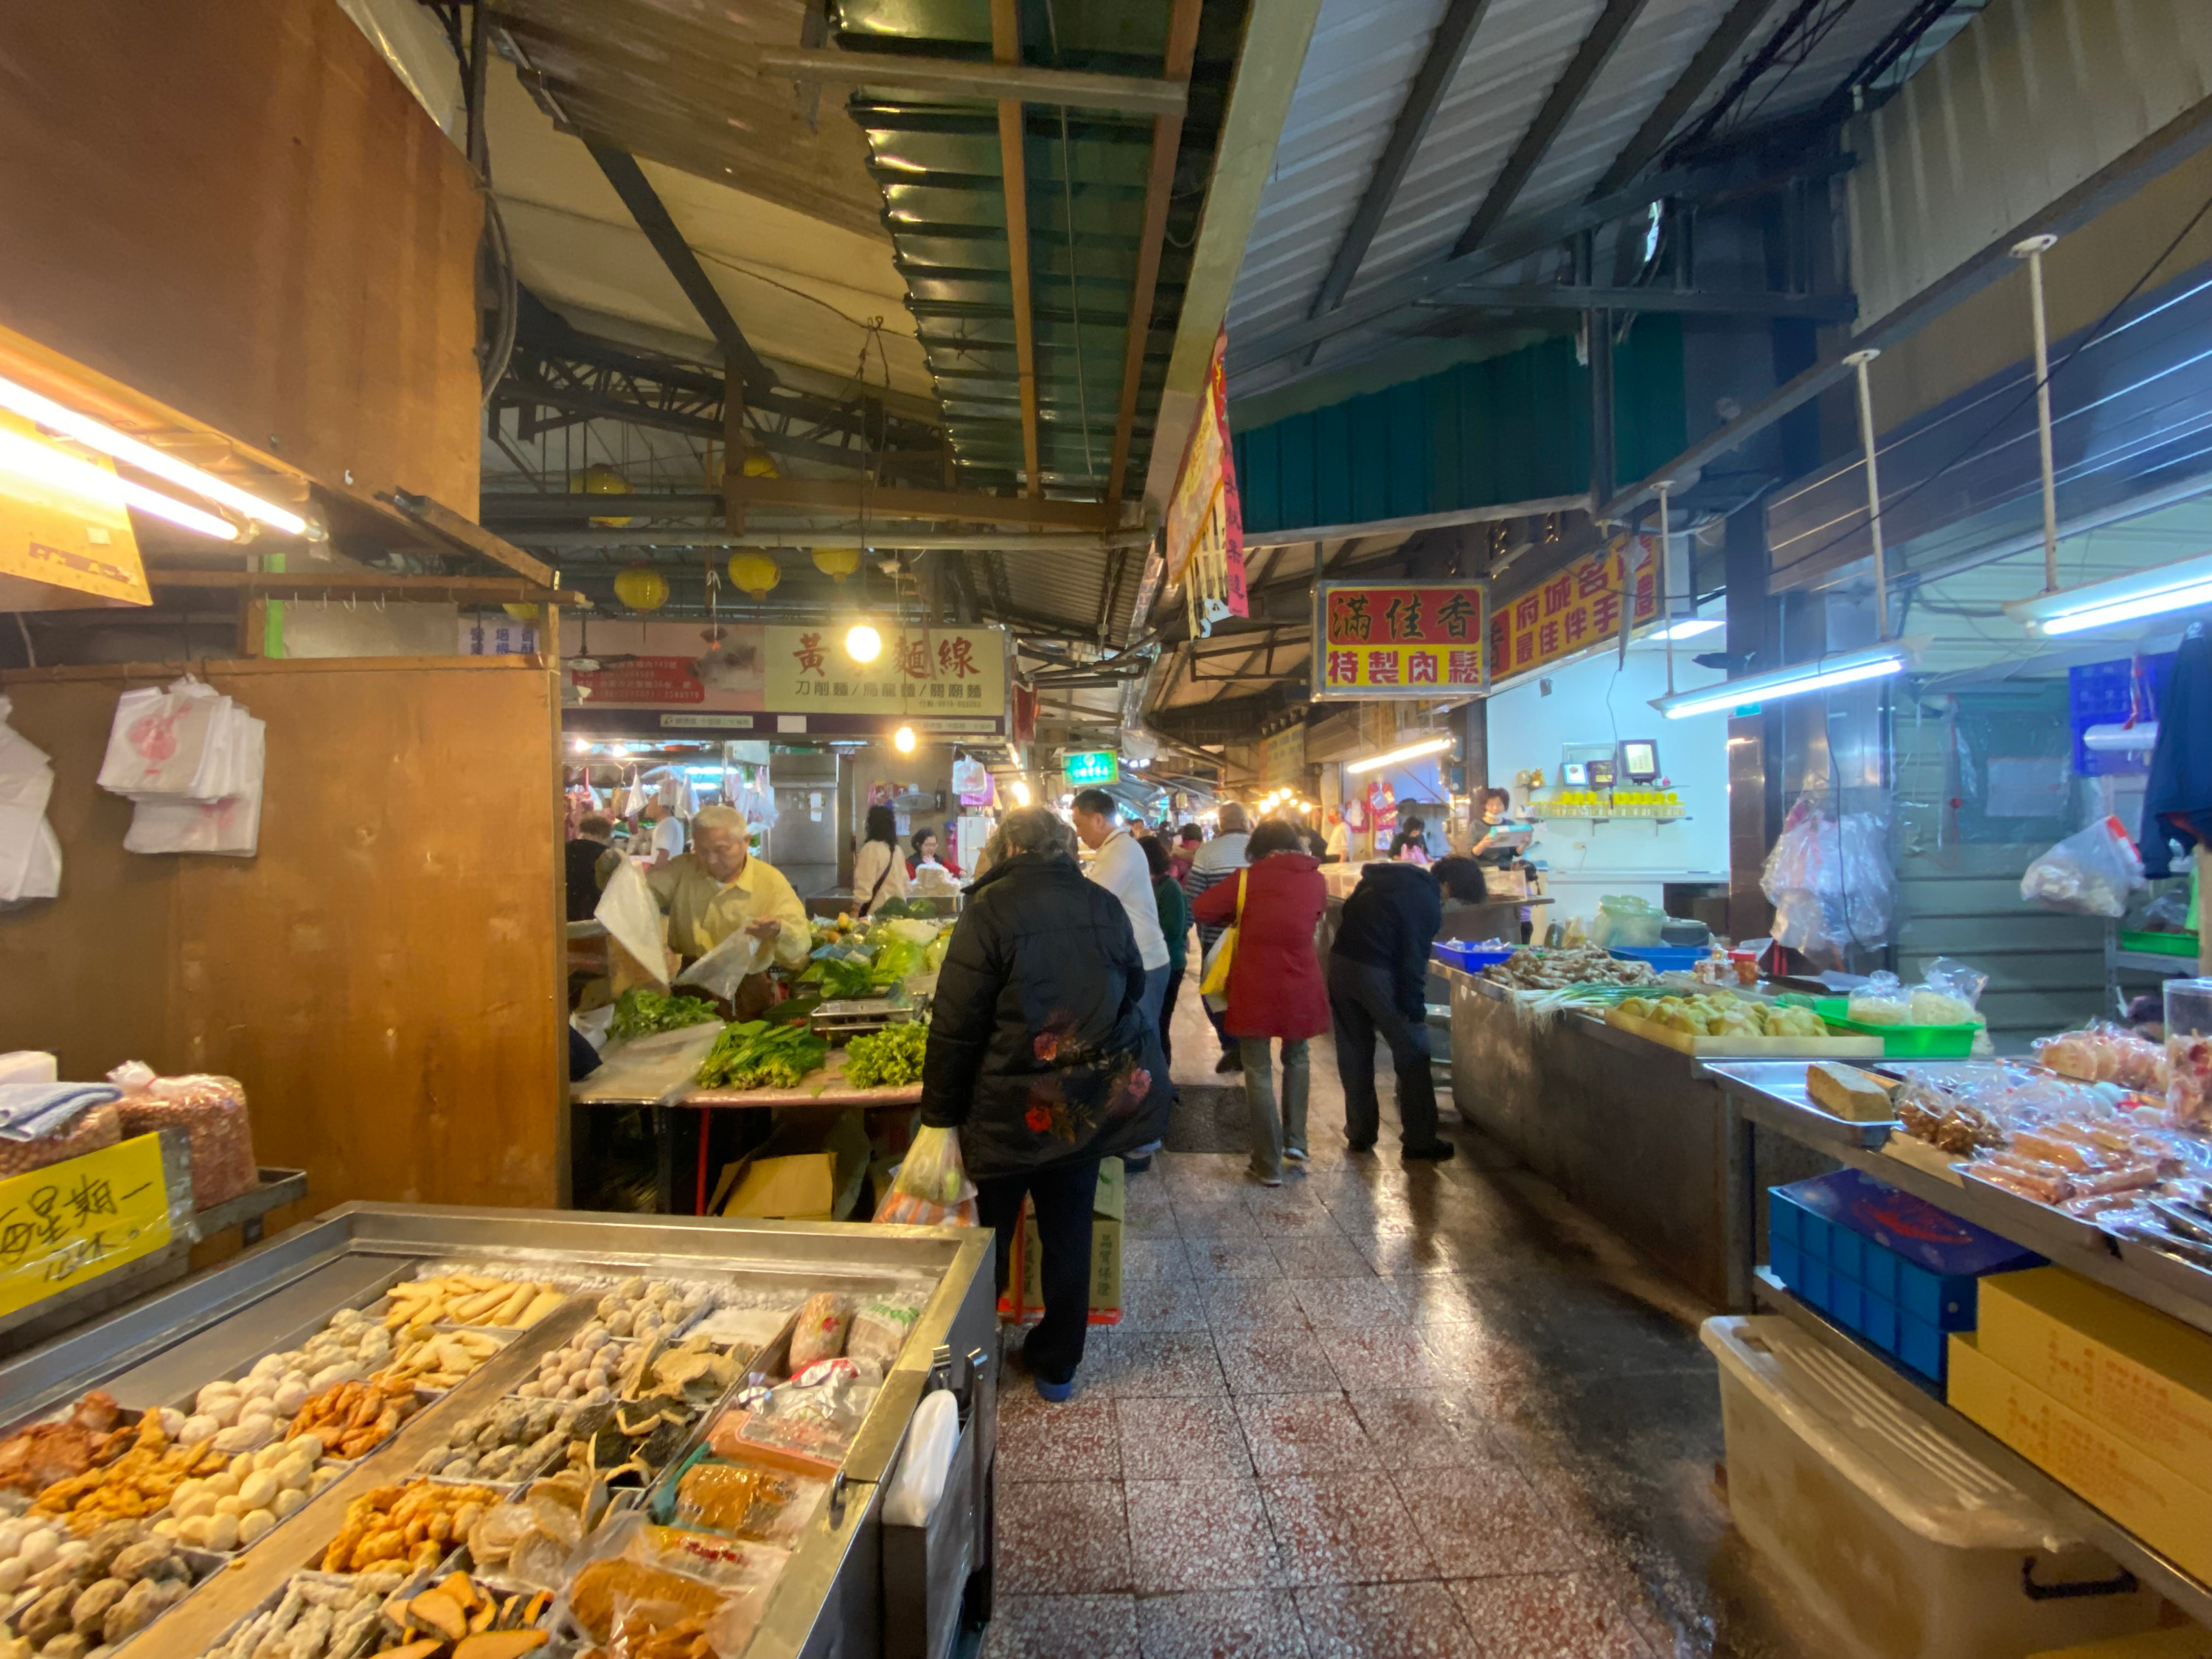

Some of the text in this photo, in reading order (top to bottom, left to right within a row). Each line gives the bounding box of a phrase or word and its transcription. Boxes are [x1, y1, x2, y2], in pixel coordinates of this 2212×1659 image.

[1332, 593, 1475, 641] 滿佳香
[793, 633, 980, 679] 黃麵線
[1328, 650, 1479, 684] 特製肉鬆
[0, 1174, 153, 1264] 每星期一
